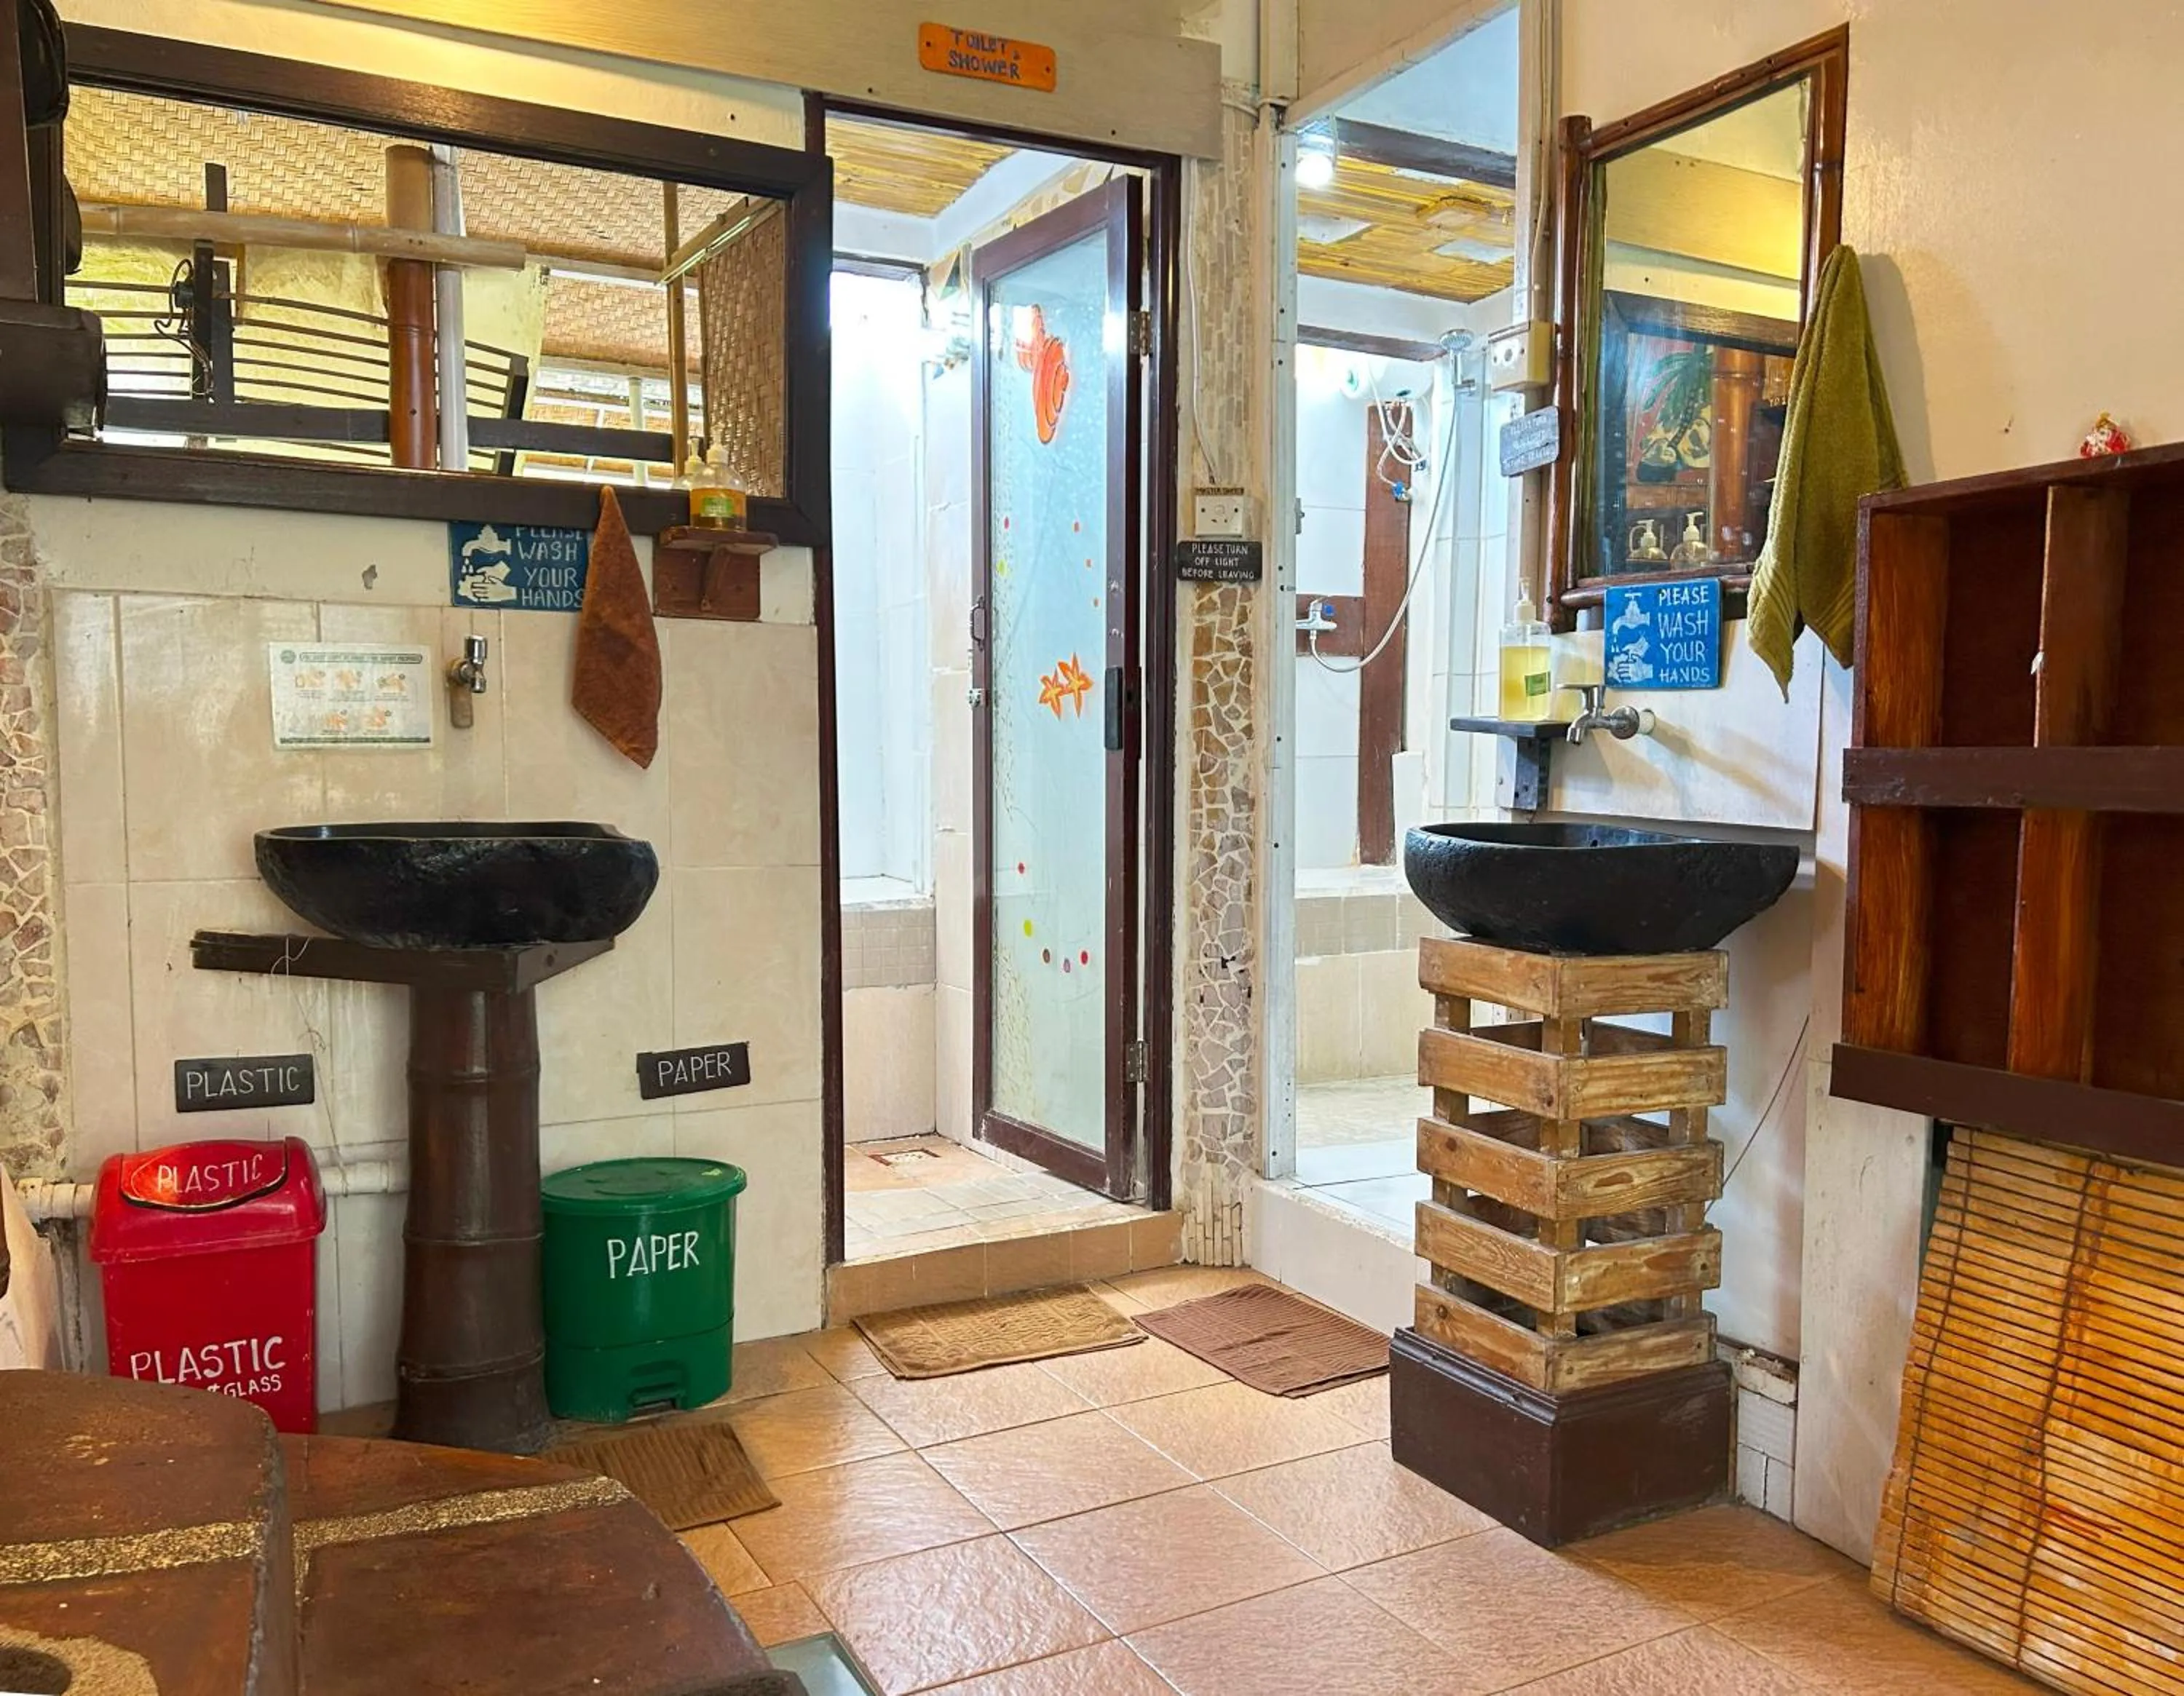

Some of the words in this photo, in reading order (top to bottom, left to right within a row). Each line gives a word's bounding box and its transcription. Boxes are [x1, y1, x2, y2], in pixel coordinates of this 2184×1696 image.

[950, 29, 1008, 54] TOILET
[949, 49, 1020, 79] SHOWER
[518, 541, 577, 561] WASH
[1192, 543, 1223, 554] PLEASE
[1225, 544, 1249, 555] TURN
[1182, 568, 1214, 578] BEFORE
[1218, 570, 1254, 579] LEAVING
[1195, 557, 1210, 566] OFF
[1215, 557, 1239, 566] LIGHT
[524, 566, 579, 588] YOUR
[521, 587, 585, 608] HANDS
[1659, 585, 1709, 606] PLEASE
[1658, 610, 1709, 639] WASH
[1660, 640, 1706, 664] YOUR
[1660, 667, 1709, 683] HANDS
[658, 1052, 732, 1087] PAPER
[186, 1066, 300, 1100] PLASTIC
[157, 1154, 262, 1193] PLASTIC
[607, 1231, 700, 1279] PAPER
[130, 1336, 286, 1384] PLASTIC
[223, 1374, 282, 1398] GLASS
